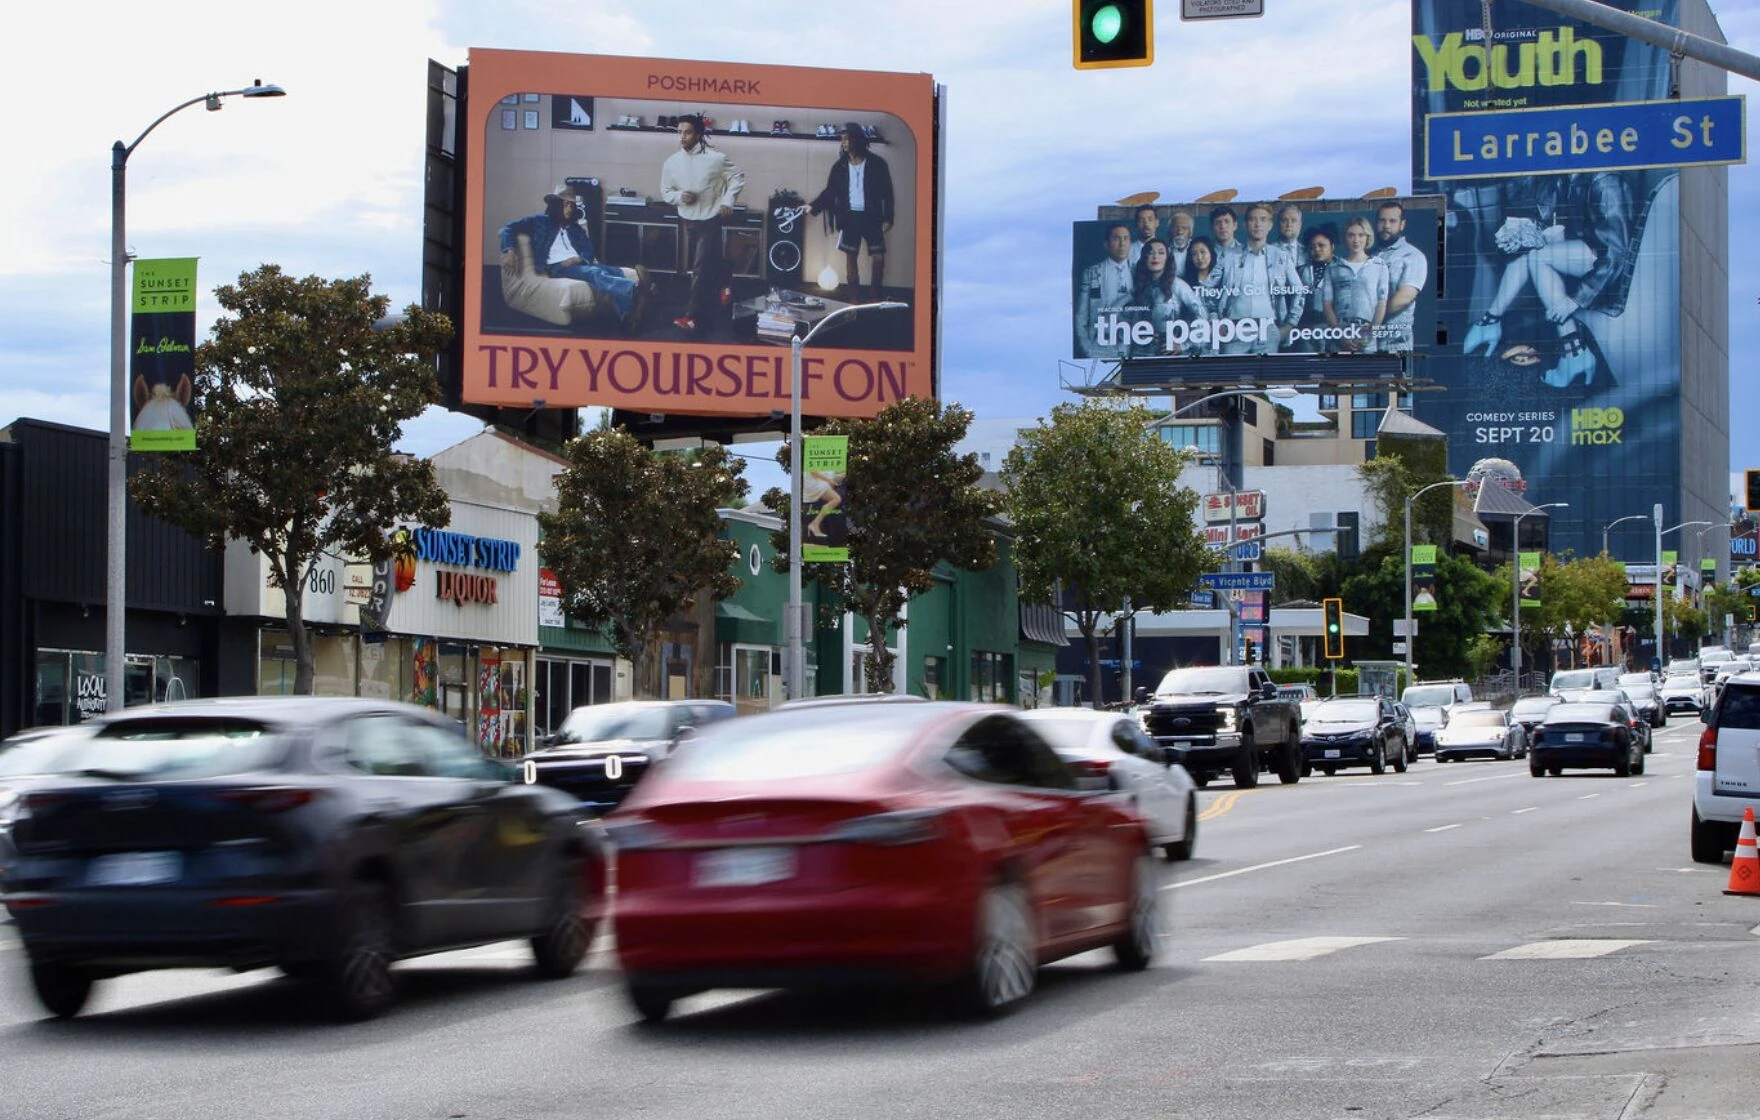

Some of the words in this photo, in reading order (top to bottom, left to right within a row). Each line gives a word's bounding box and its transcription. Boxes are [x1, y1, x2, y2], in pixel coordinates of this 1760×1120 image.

[1494, 30, 1537, 40] ORIGINAL
[1412, 26, 1603, 92] Youth
[647, 75, 760, 94] POSHMARK
[1464, 100, 1479, 108] Not
[1480, 98, 1511, 107] wsted
[1512, 97, 1527, 107] yet
[1453, 123, 1639, 161] Larrabee
[1670, 105, 1715, 149] St
[140, 278, 189, 289] SUNSET
[1193, 285, 1240, 299] They've
[1270, 284, 1313, 296] Issues.
[140, 295, 189, 306] STRIP
[1094, 313, 1155, 346] the
[1166, 317, 1275, 351] paper
[1289, 323, 1362, 345] peacock
[479, 345, 570, 390] TRY
[579, 349, 825, 400] YOURSELF
[1466, 413, 1514, 422] COMEDY
[1518, 411, 1555, 421] SERIES
[1571, 407, 1625, 429] HBO
[1475, 428, 1524, 443] SEPT
[1529, 427, 1554, 443] 20
[1571, 429, 1622, 446] max
[1245, 505, 1259, 516] OIL
[415, 528, 475, 567] SUNSET
[475, 537, 521, 573] STRIP
[437, 570, 498, 606] LIQUOR
[1218, 576, 1251, 587] Vicente
[1253, 575, 1272, 586] Blvd
[77, 674, 107, 697] LOCAL
